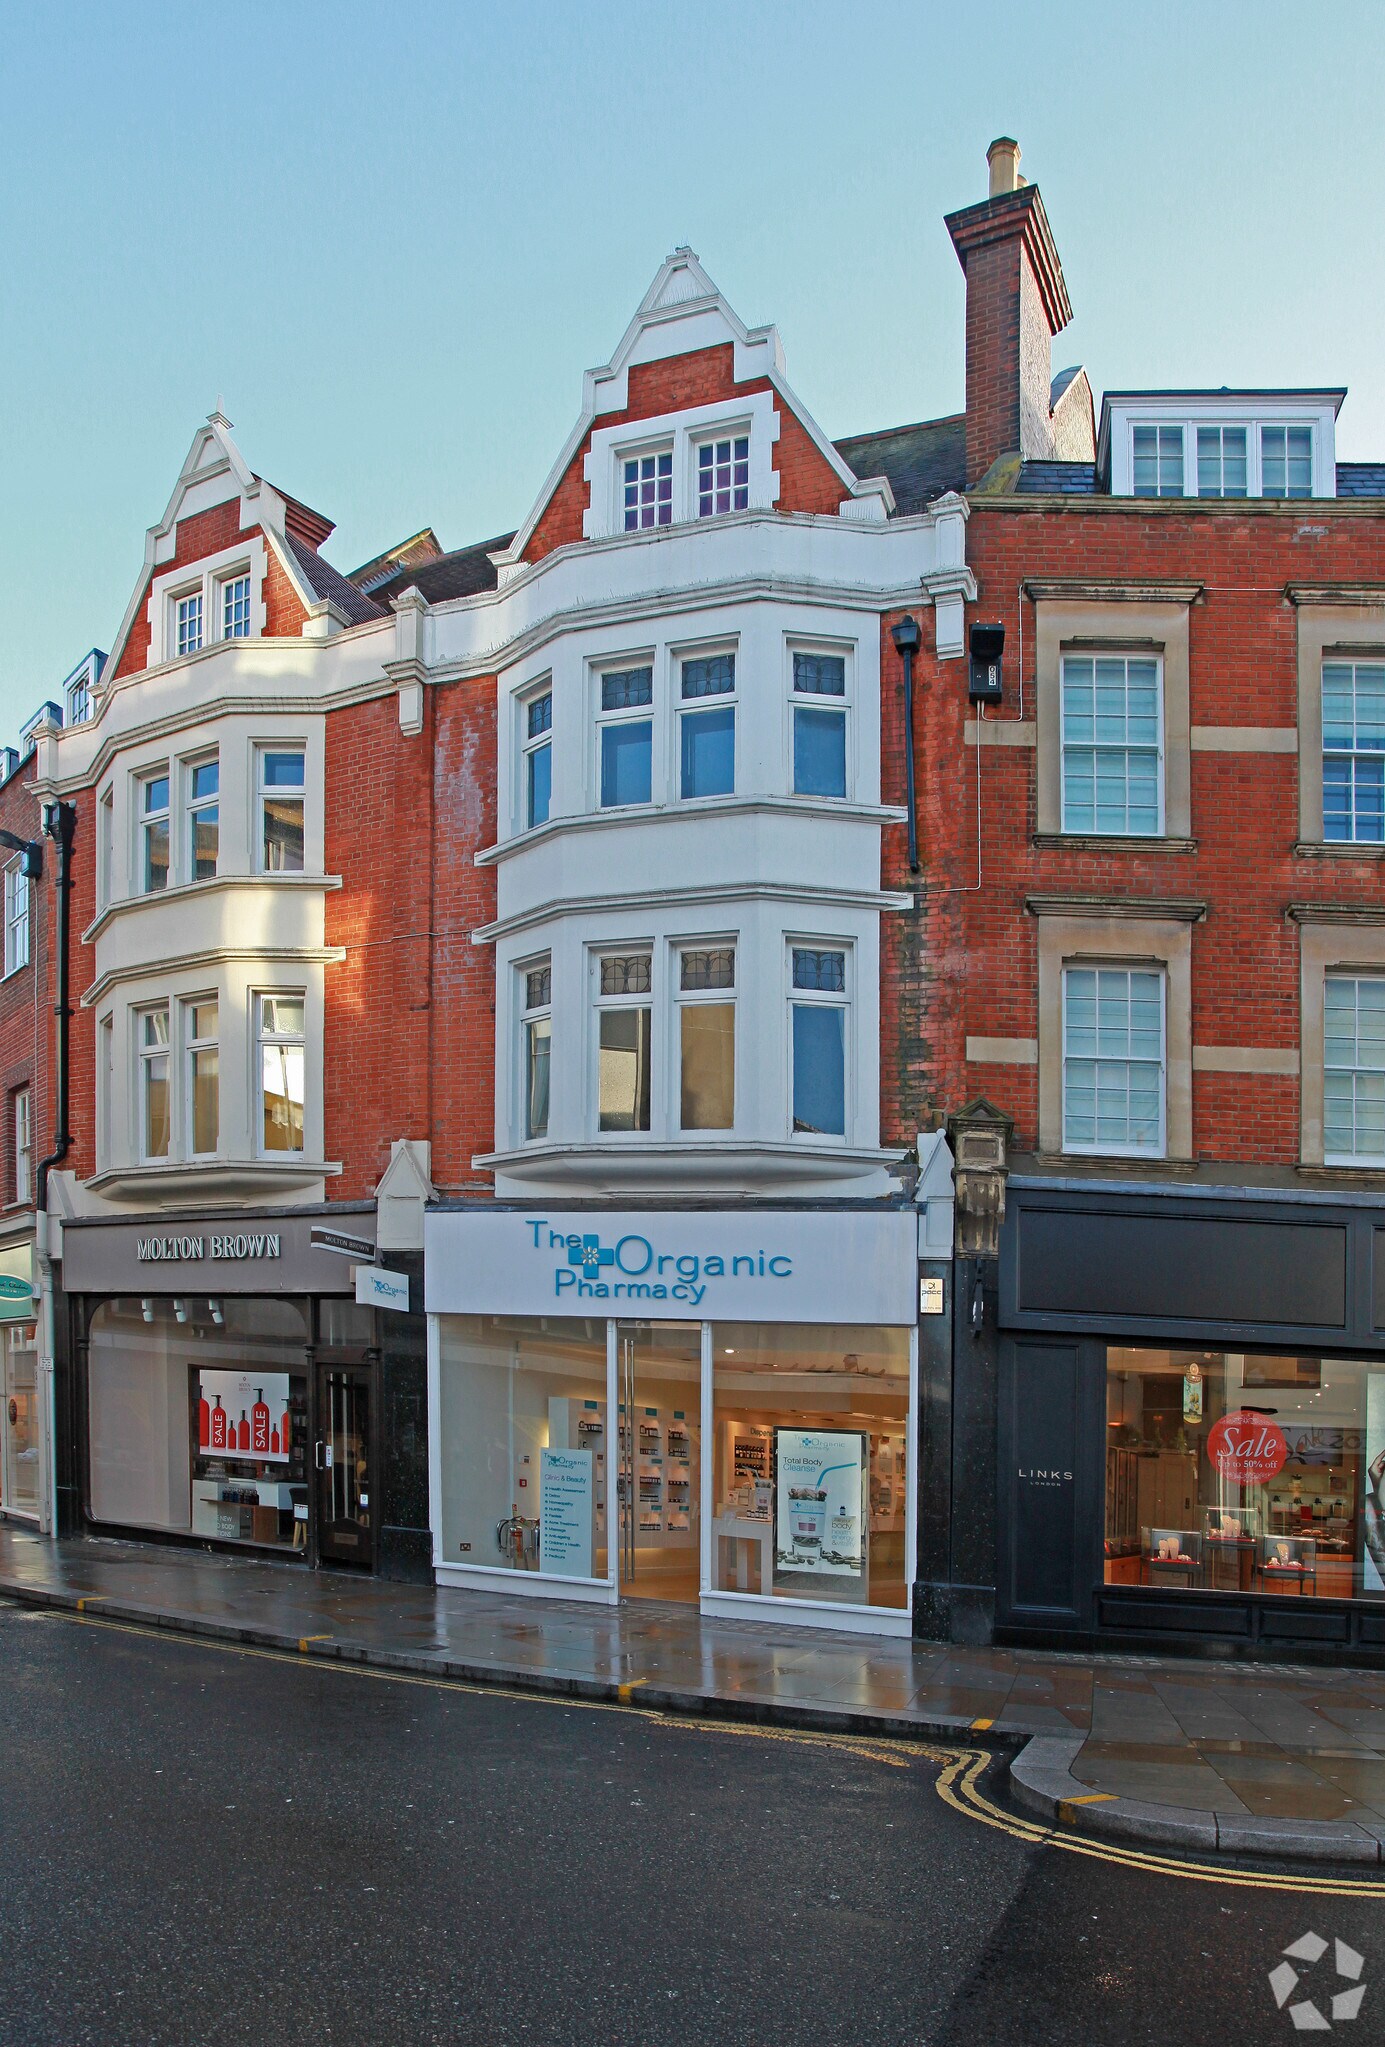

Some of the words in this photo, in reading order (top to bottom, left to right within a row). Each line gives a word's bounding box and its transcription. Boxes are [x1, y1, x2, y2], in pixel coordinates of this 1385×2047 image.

[137, 1236, 204, 1260] MOLTON
[208, 1233, 280, 1259] BROWN
[325, 1235, 348, 1247] MOLTON
[348, 1241, 370, 1252] BROWN
[525, 1220, 582, 1248] The
[615, 1234, 792, 1284] Organic
[383, 1282, 407, 1295] Organic
[555, 1268, 707, 1306] Pharmacy
[214, 1414, 223, 1445] SALE
[255, 1410, 266, 1448] SALE
[811, 1437, 845, 1448] Organic
[1217, 1427, 1278, 1458] Sale
[559, 1456, 588, 1467] Organic
[783, 1463, 816, 1473] Cleanse
[804, 1457, 823, 1467] Body
[1217, 1459, 1230, 1470] Up
[1232, 1460, 1242, 1469] to
[1244, 1459, 1263, 1469] 50%
[1265, 1459, 1278, 1469] off
[545, 1473, 560, 1481] Clinic
[567, 1475, 587, 1484] Beauty
[1018, 1468, 1073, 1481] LINKS
[221, 1523, 236, 1531] BODY
[832, 1521, 853, 1531] body
